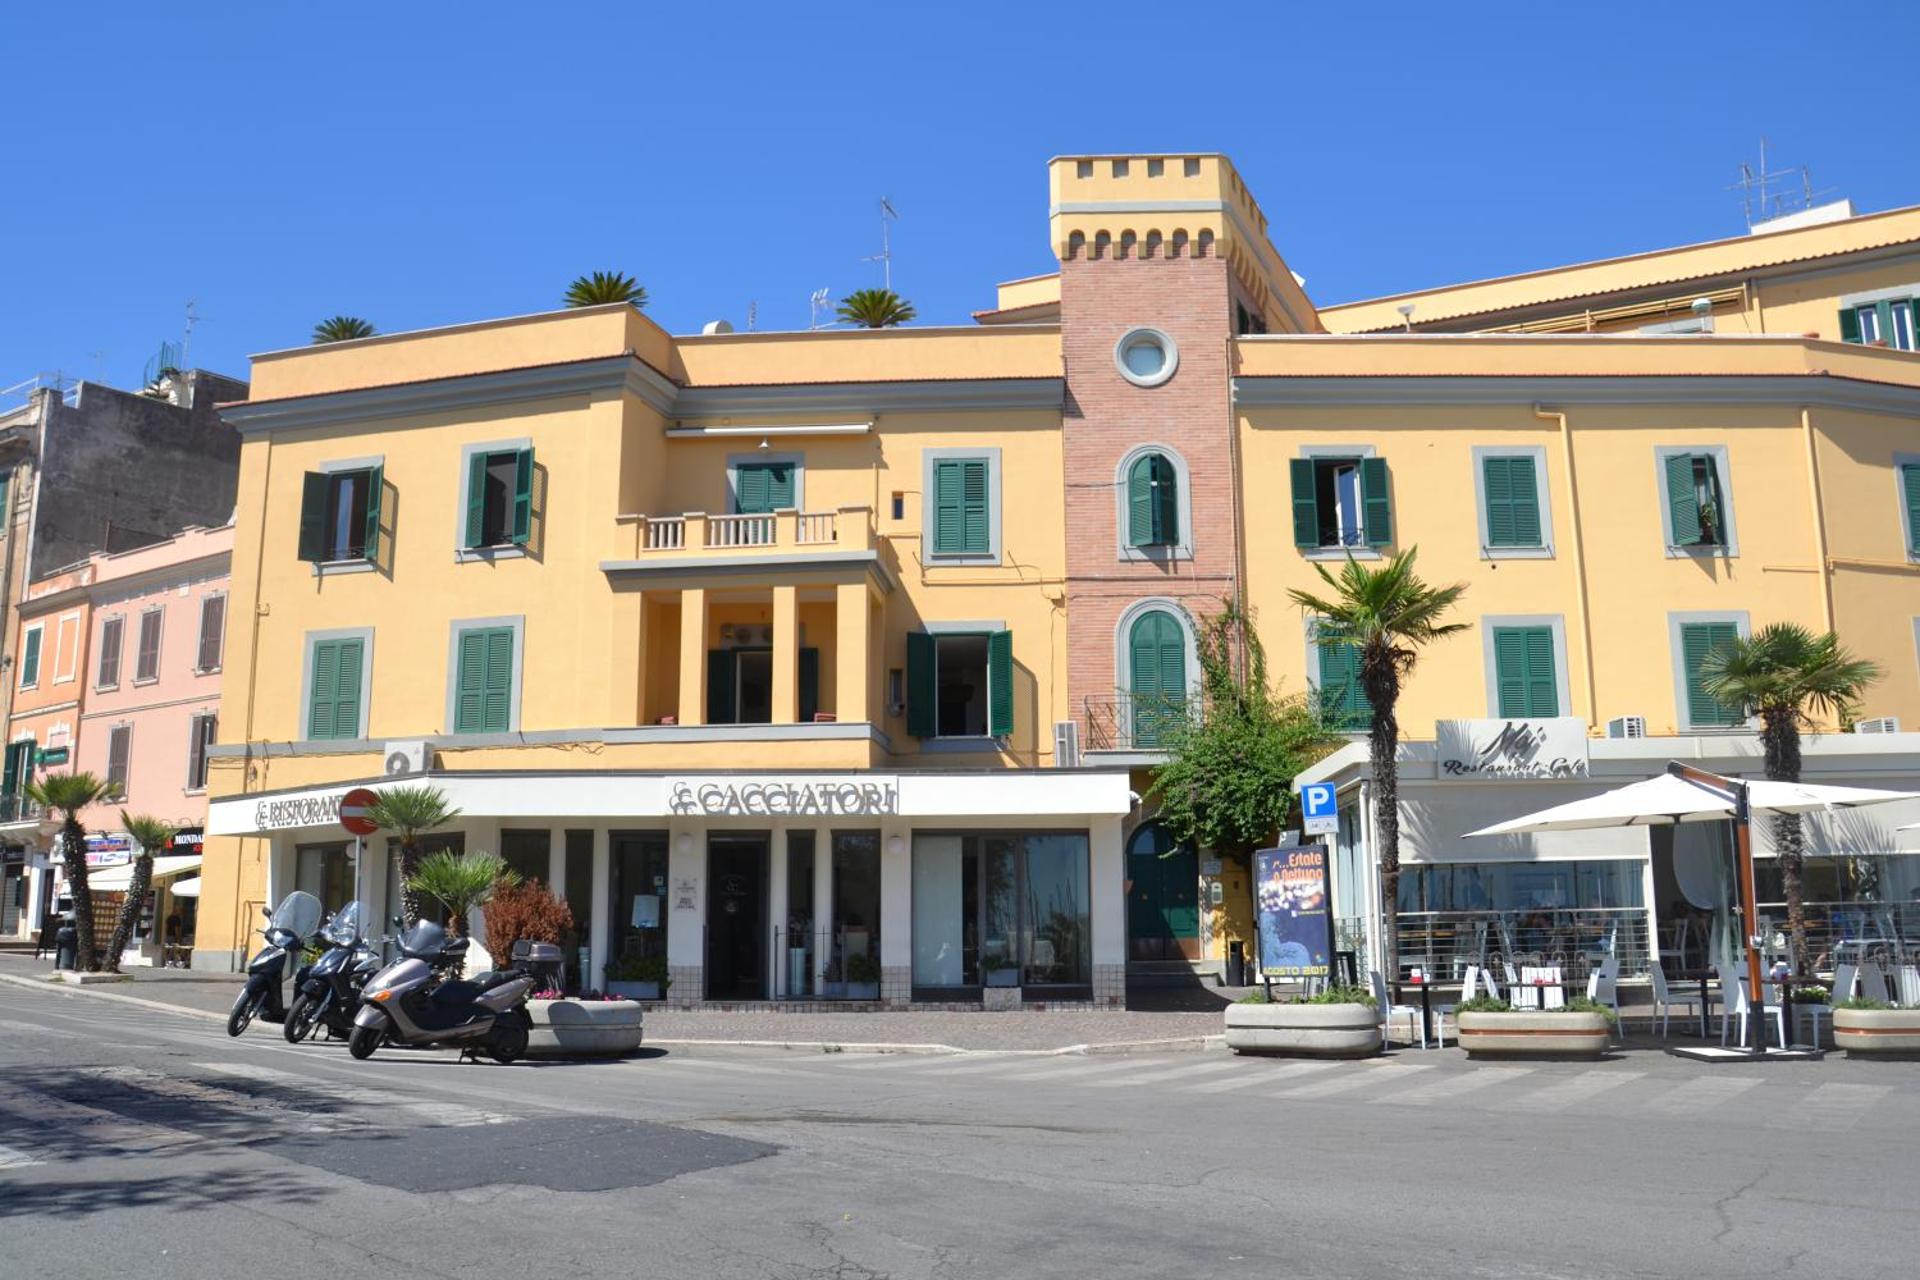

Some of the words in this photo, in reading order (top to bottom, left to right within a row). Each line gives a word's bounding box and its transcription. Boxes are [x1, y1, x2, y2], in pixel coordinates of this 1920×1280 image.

[1443, 759, 1540, 776] Restaurant
[697, 782, 891, 808] CACCIATORI
[1307, 786, 1330, 815] P
[1263, 966, 1299, 976] AGOSTO
[1303, 965, 1329, 976] 2017
